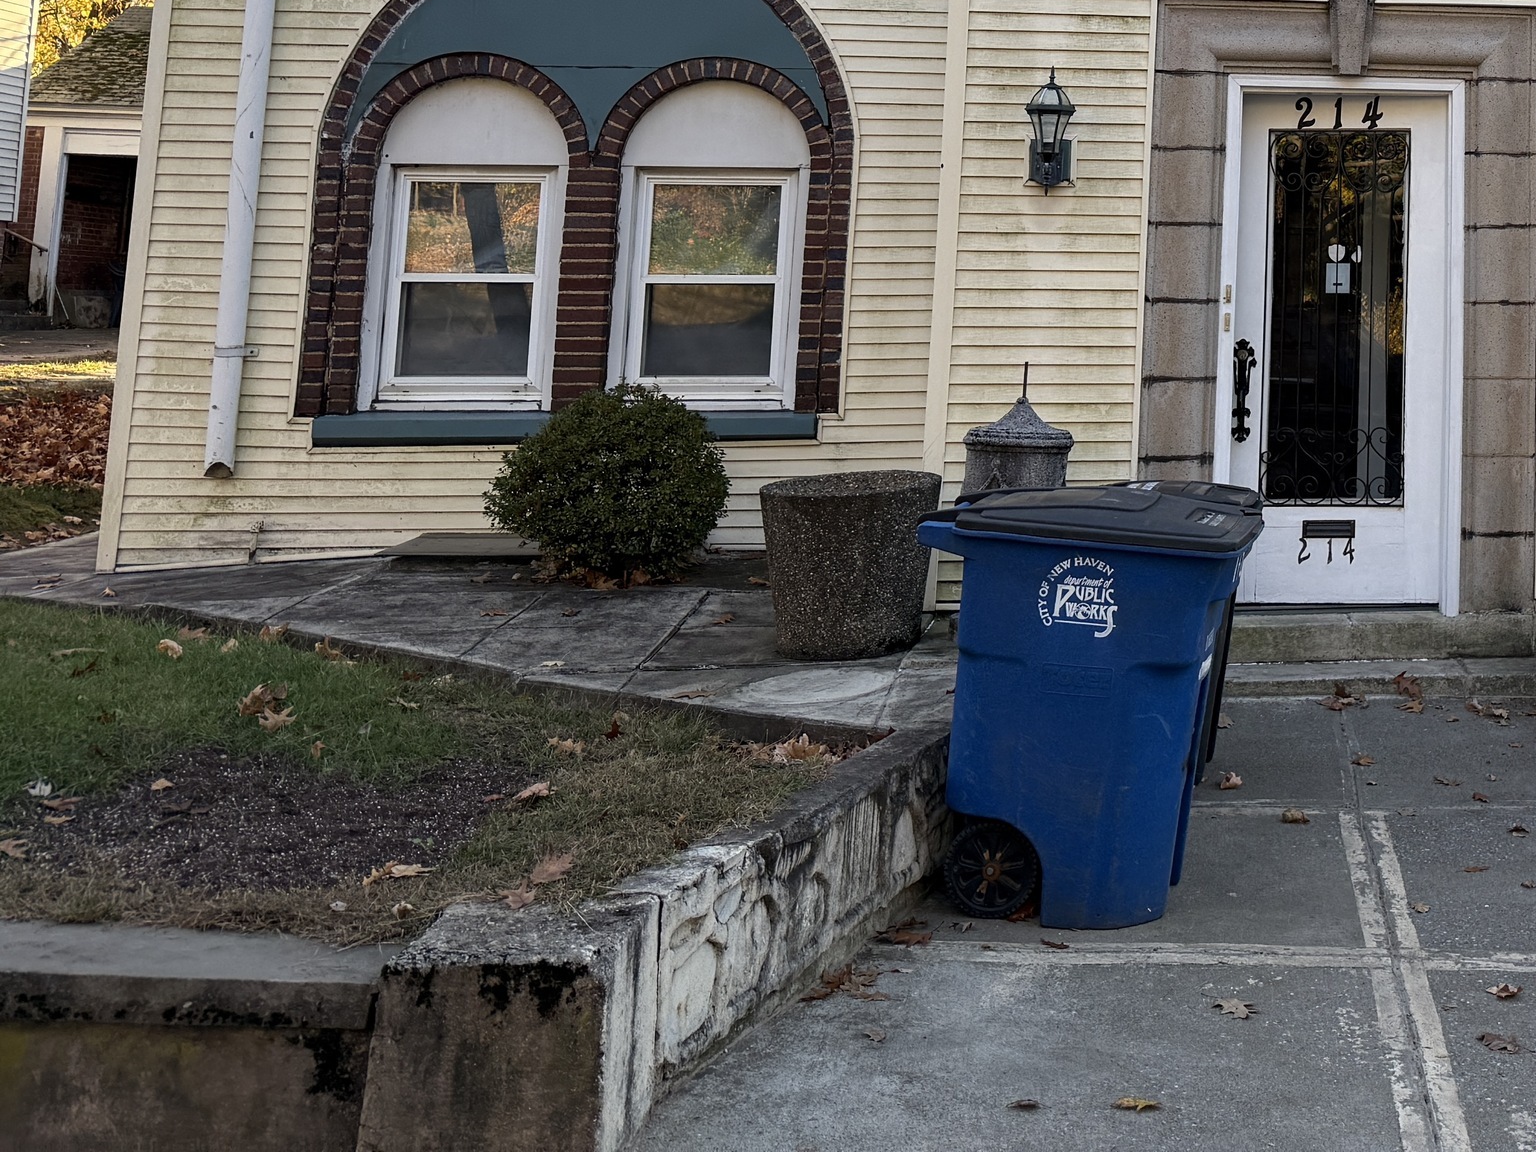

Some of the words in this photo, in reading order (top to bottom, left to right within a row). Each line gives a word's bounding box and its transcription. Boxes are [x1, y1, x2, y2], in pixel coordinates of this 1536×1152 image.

[1295, 96, 1383, 130] 214
[1298, 538, 1355, 565] 214
[1047, 559, 1071, 581] NEW
[1074, 556, 1115, 576] HAVEN
[1039, 581, 1050, 597] OF
[1064, 575, 1103, 588] department
[1103, 578, 1114, 589] of
[1038, 599, 1053, 627] CITY
[1052, 583, 1115, 617] PUBLIC
[1065, 601, 1118, 638] WORKS
